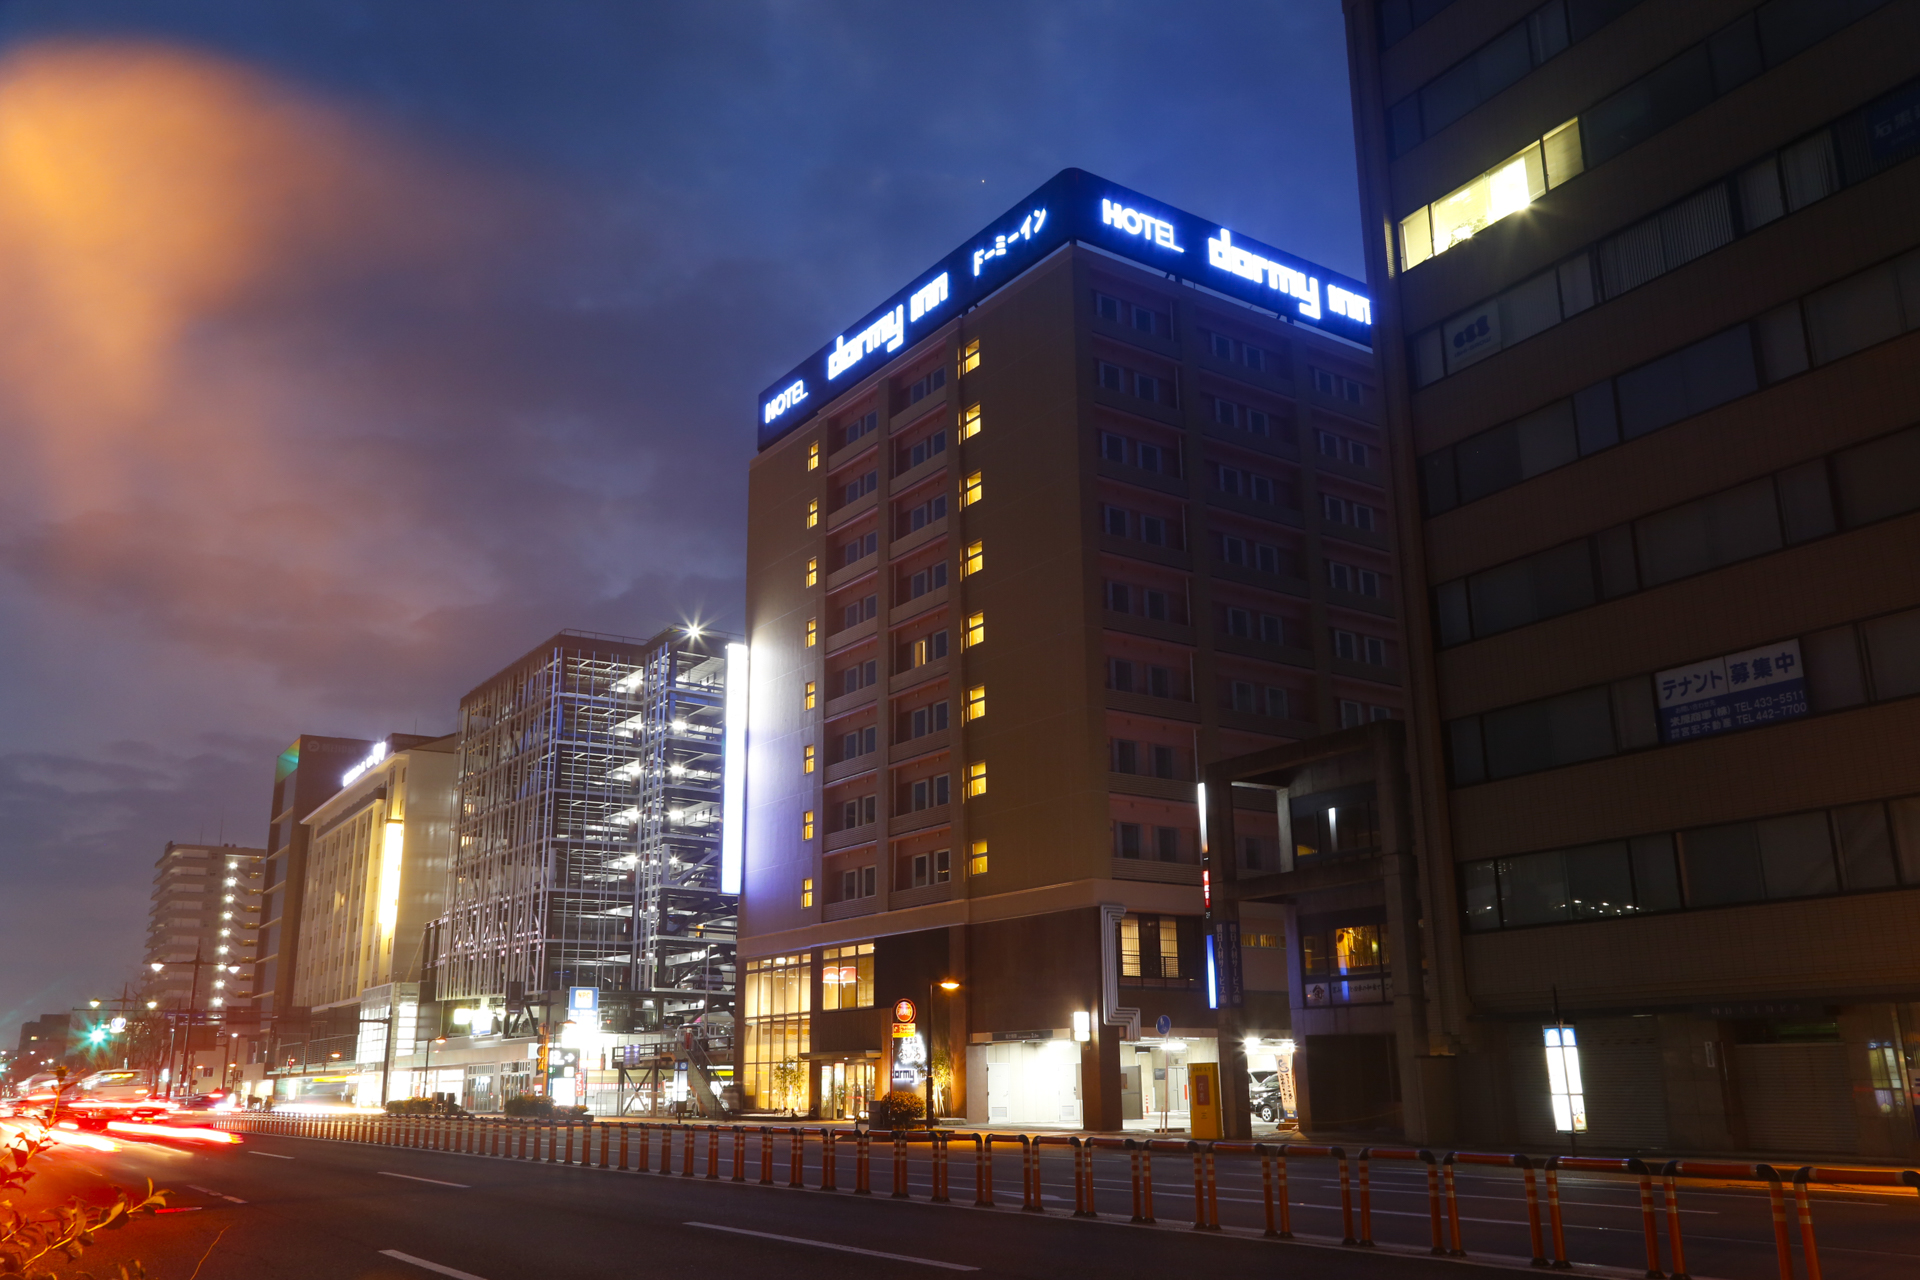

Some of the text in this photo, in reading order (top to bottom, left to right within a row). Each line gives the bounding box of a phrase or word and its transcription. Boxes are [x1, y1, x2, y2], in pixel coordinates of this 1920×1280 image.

[974, 208, 1046, 276] ドーミーイン
[1102, 198, 1372, 325] HOTEL dormy inn
[765, 272, 948, 423] HOTEL dormy inn
[1734, 701, 1752, 713] TEL
[1754, 689, 1804, 709] 433-5511
[1736, 713, 1755, 725] TEL
[1756, 701, 1808, 721] 442-7700
